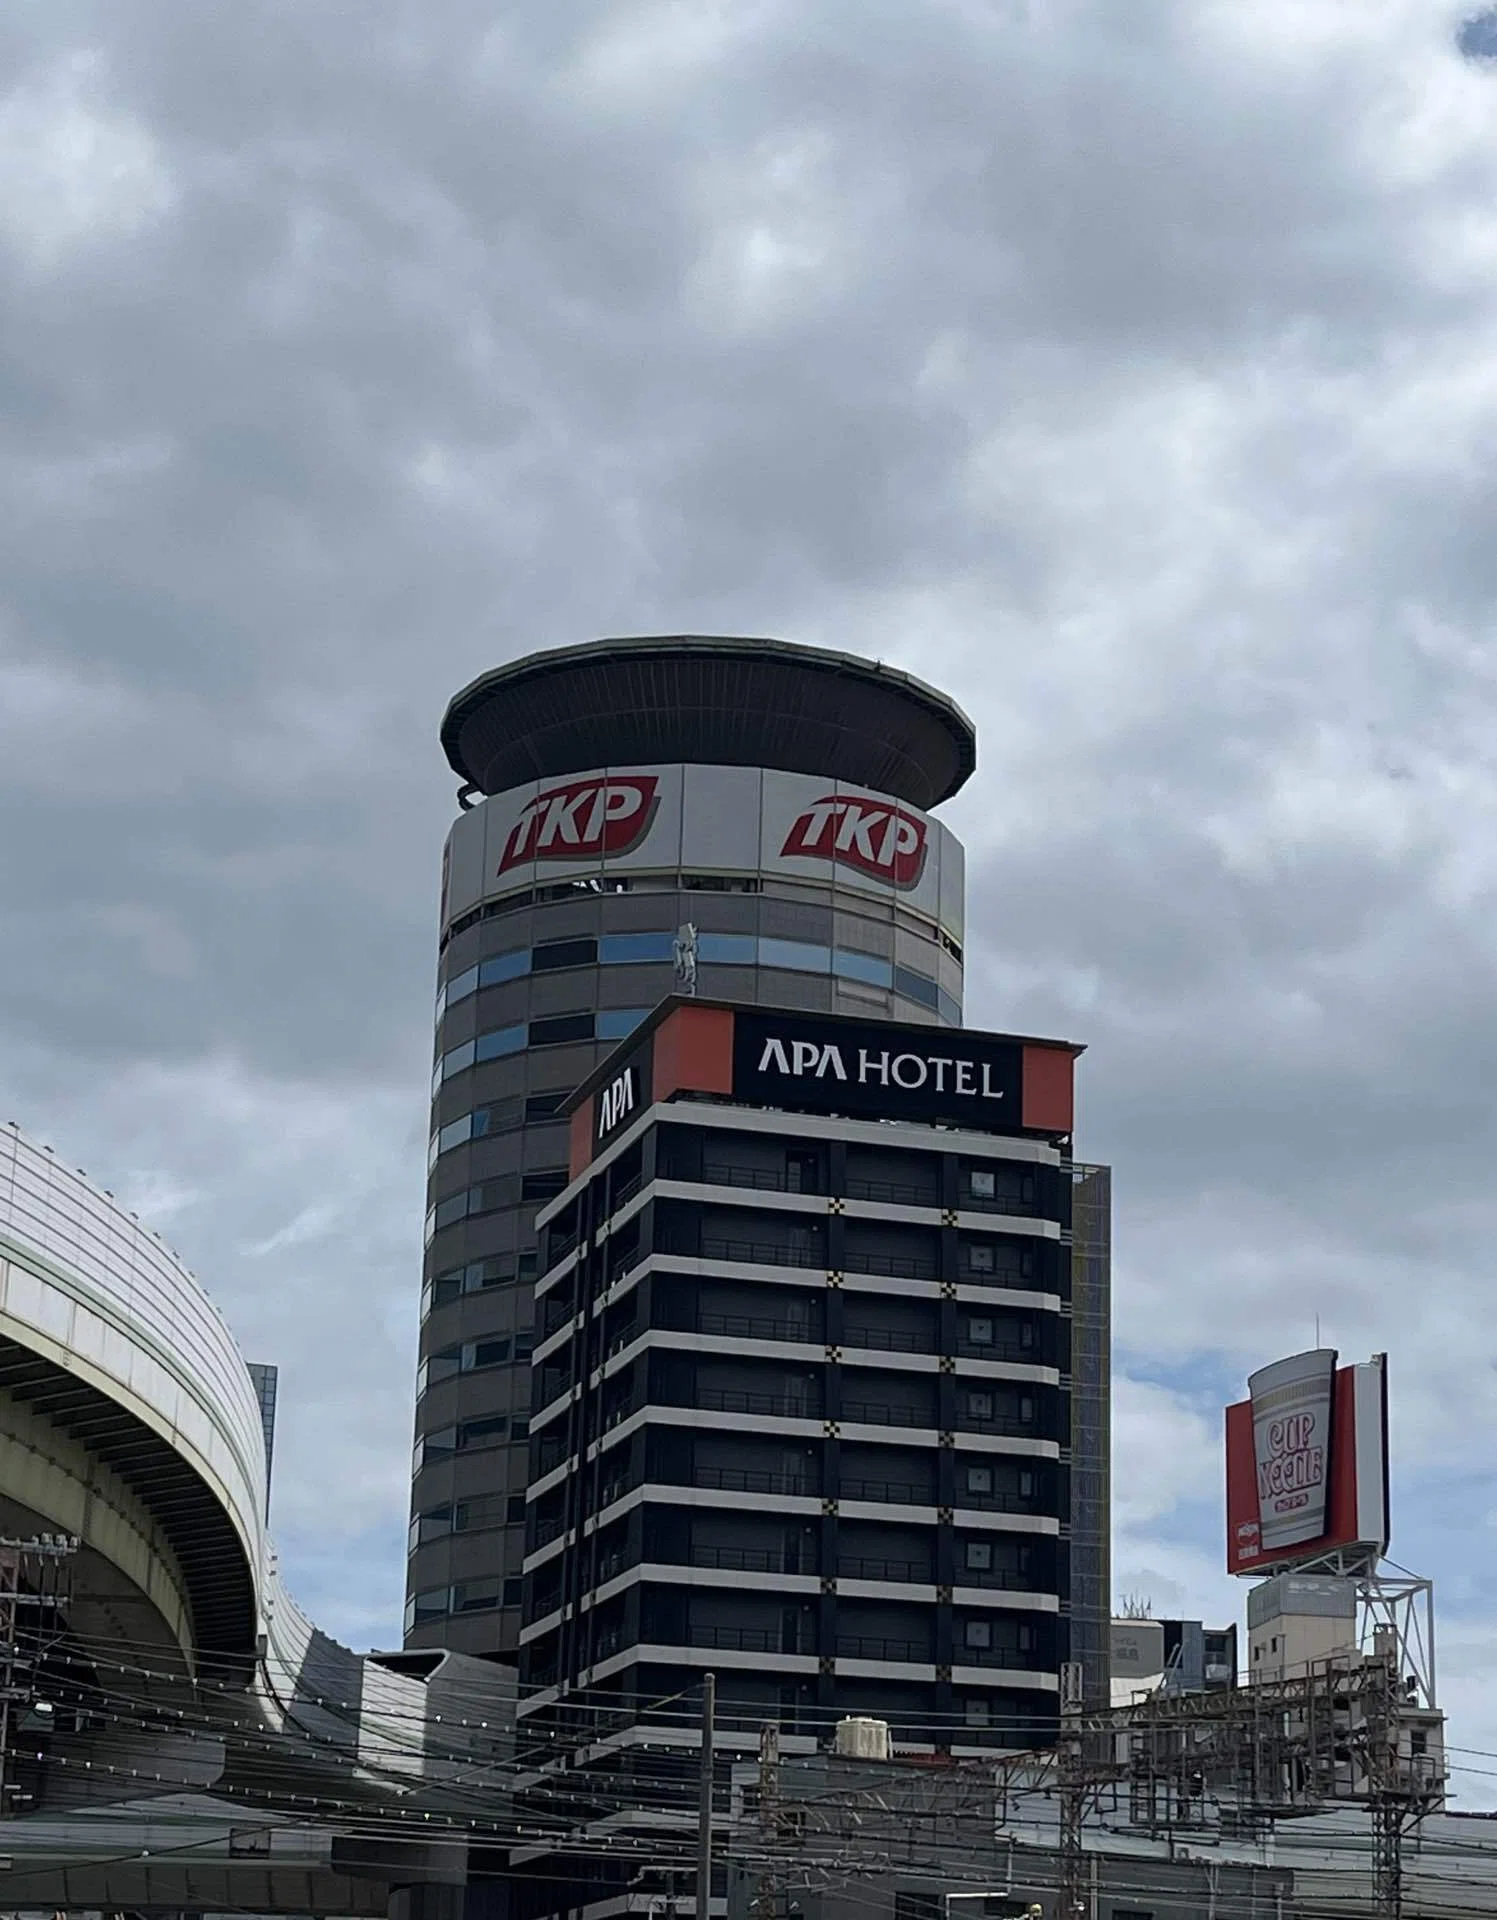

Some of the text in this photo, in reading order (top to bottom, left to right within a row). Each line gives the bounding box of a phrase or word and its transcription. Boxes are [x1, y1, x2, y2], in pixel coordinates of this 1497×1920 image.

[511, 785, 643, 857] TKP
[800, 801, 919, 867] TKP
[757, 1037, 1005, 1099] APA HOTEL
[597, 1067, 634, 1139] APA
[1268, 1412, 1315, 1459] CUP
